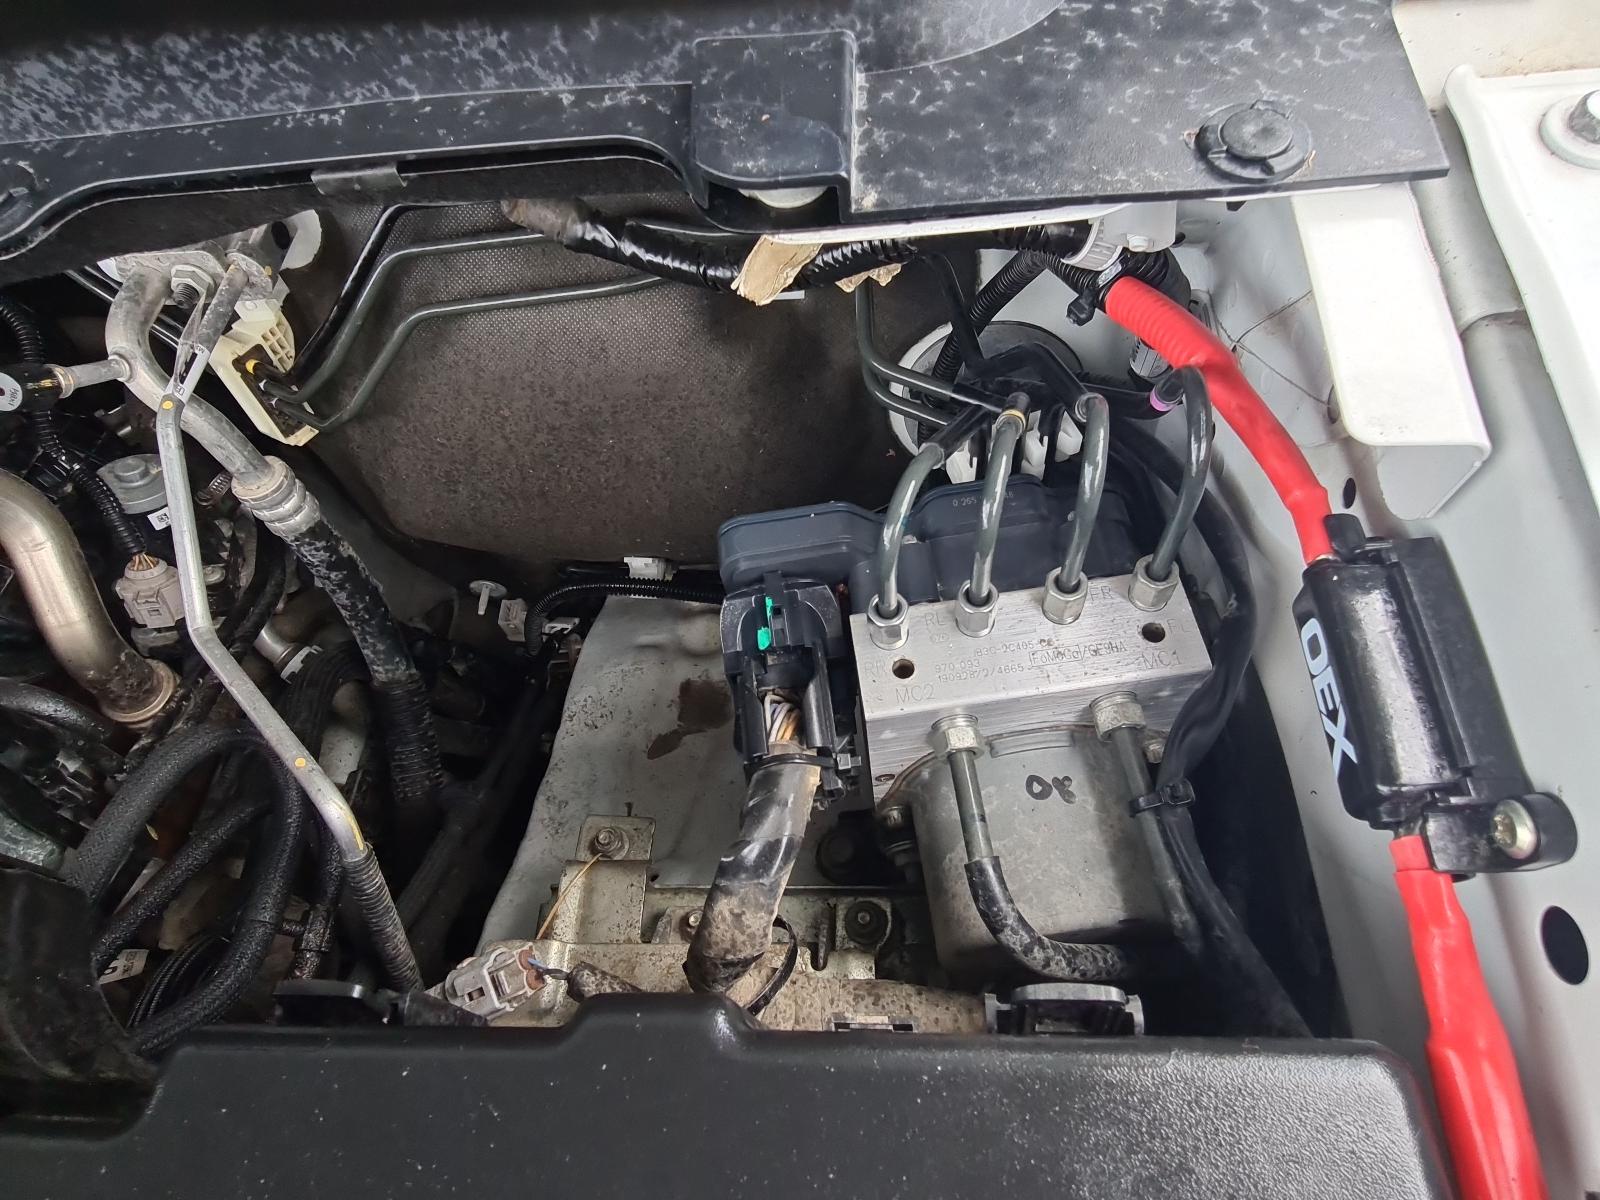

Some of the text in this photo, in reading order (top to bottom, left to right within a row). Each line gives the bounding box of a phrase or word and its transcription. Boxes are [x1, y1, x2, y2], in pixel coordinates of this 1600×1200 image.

[925, 612, 945, 625] RL
[1167, 619, 1192, 635] FL
[1142, 650, 1183, 669] MC1
[896, 684, 935, 704] MC2
[1301, 617, 1358, 778] OEX
